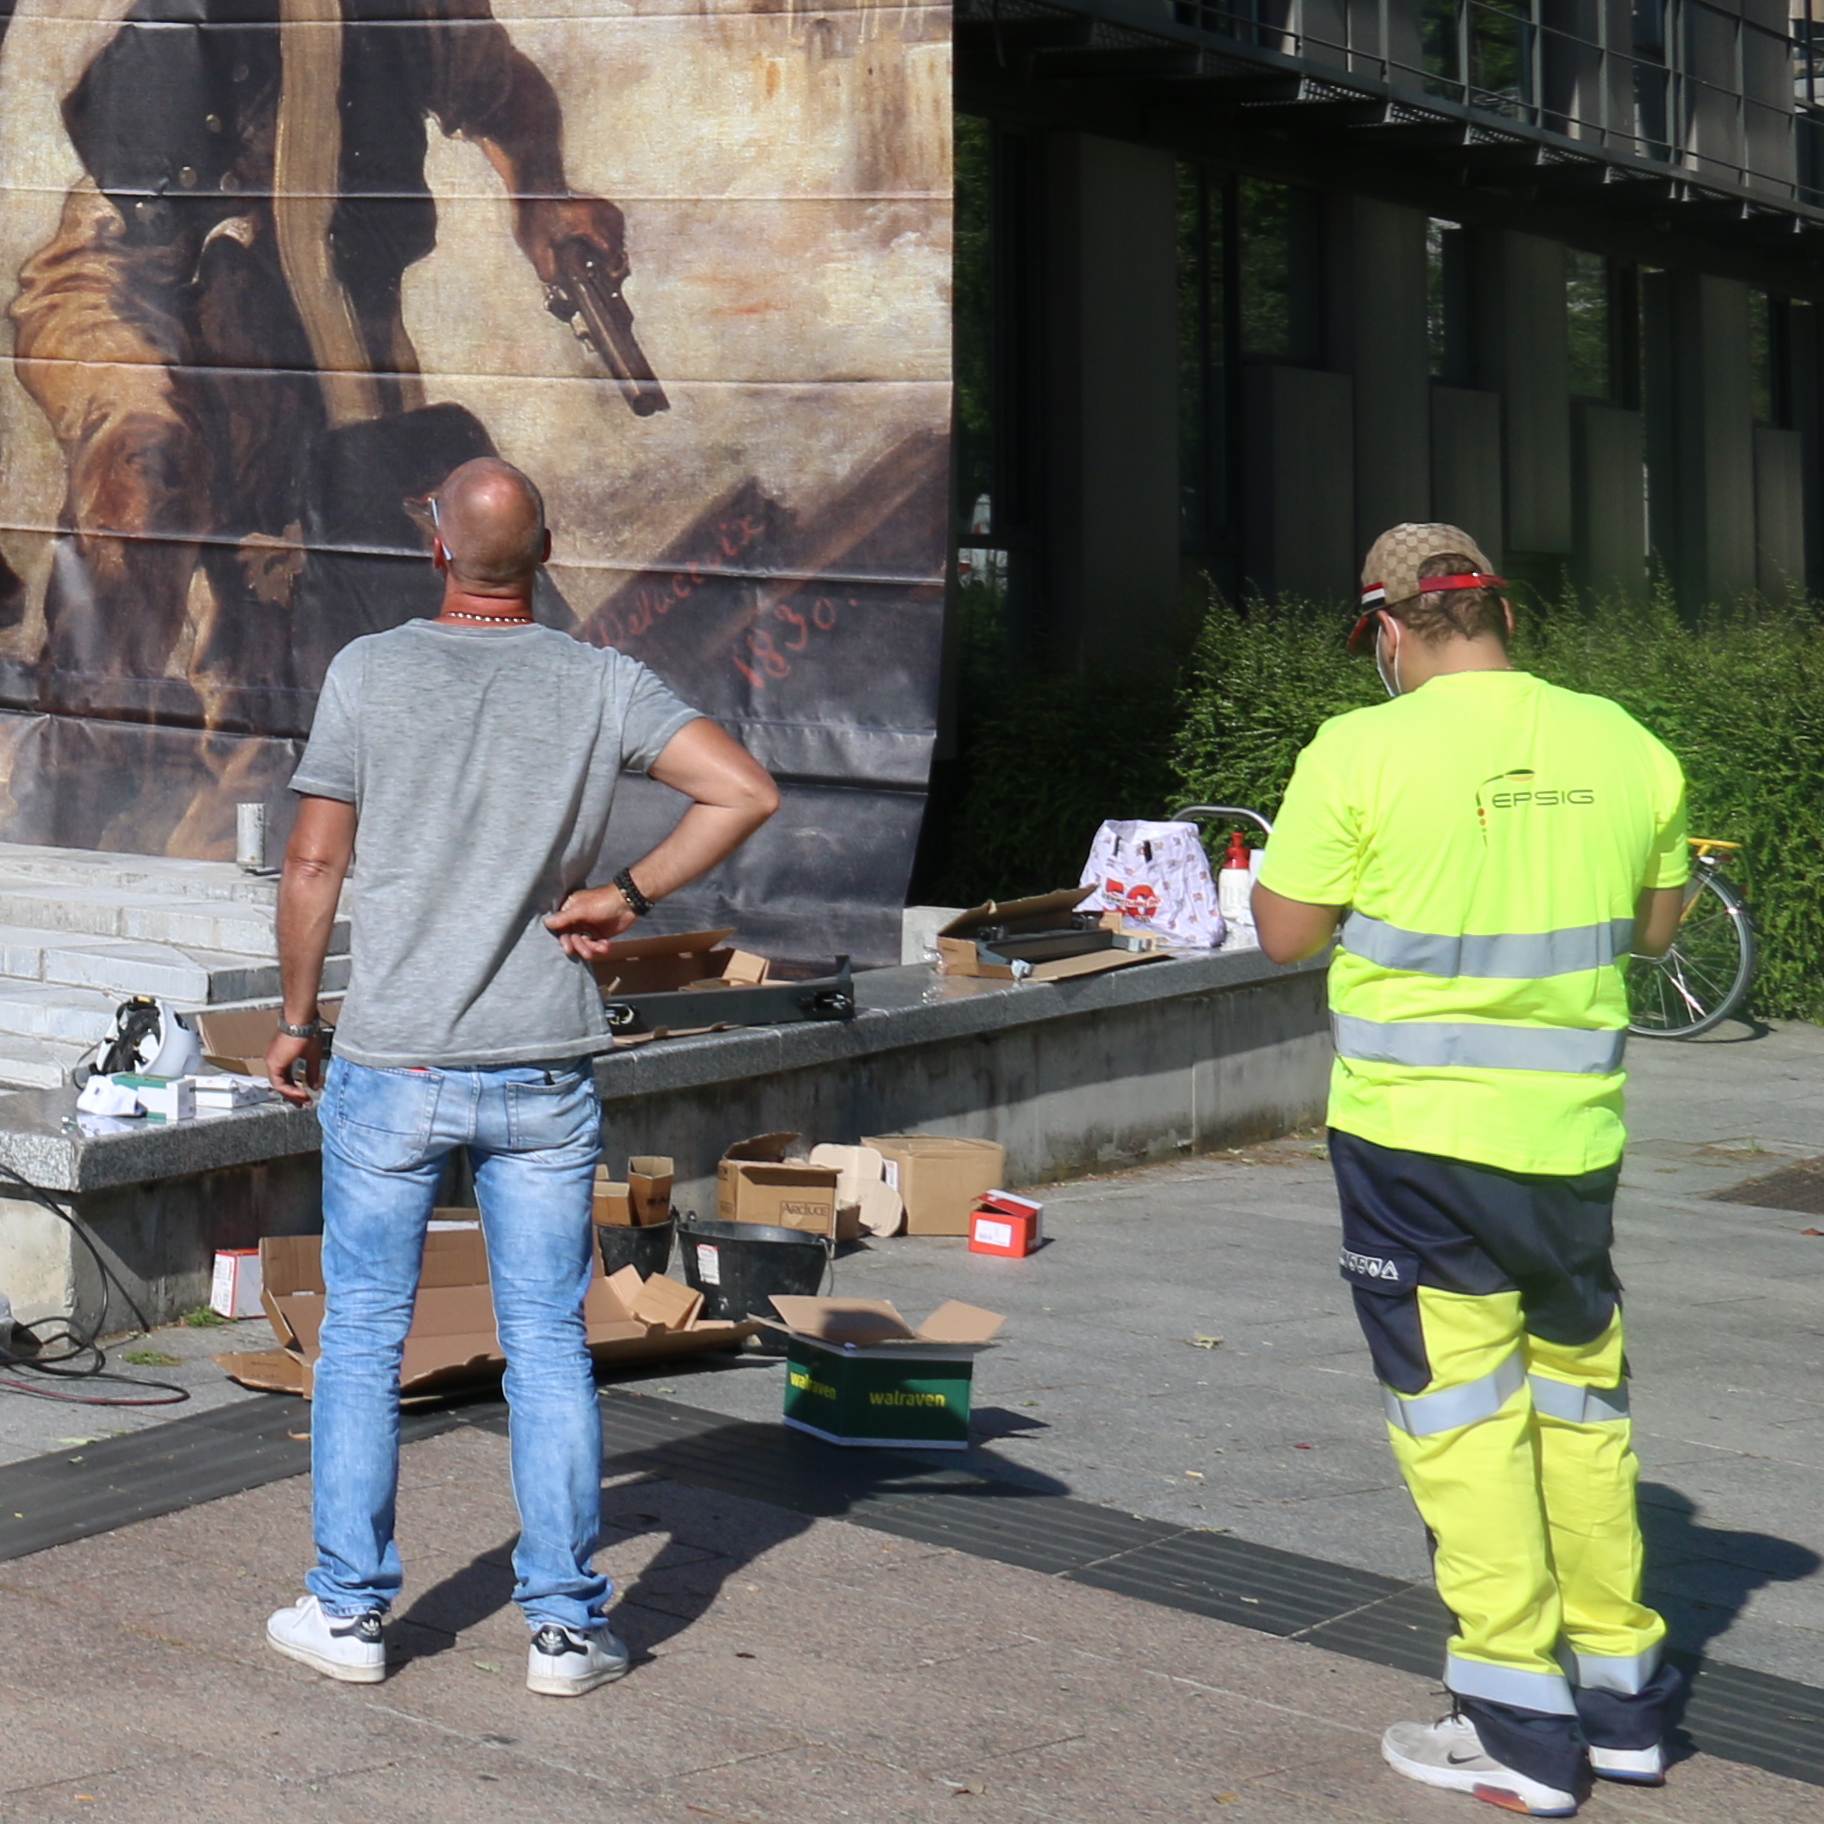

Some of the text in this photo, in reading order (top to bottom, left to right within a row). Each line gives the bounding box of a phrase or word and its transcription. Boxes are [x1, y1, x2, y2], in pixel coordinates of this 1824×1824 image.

[1492, 789, 1595, 809] EPSIG
[789, 1371, 837, 1400] walraven
[869, 1389, 949, 1408] walraven
